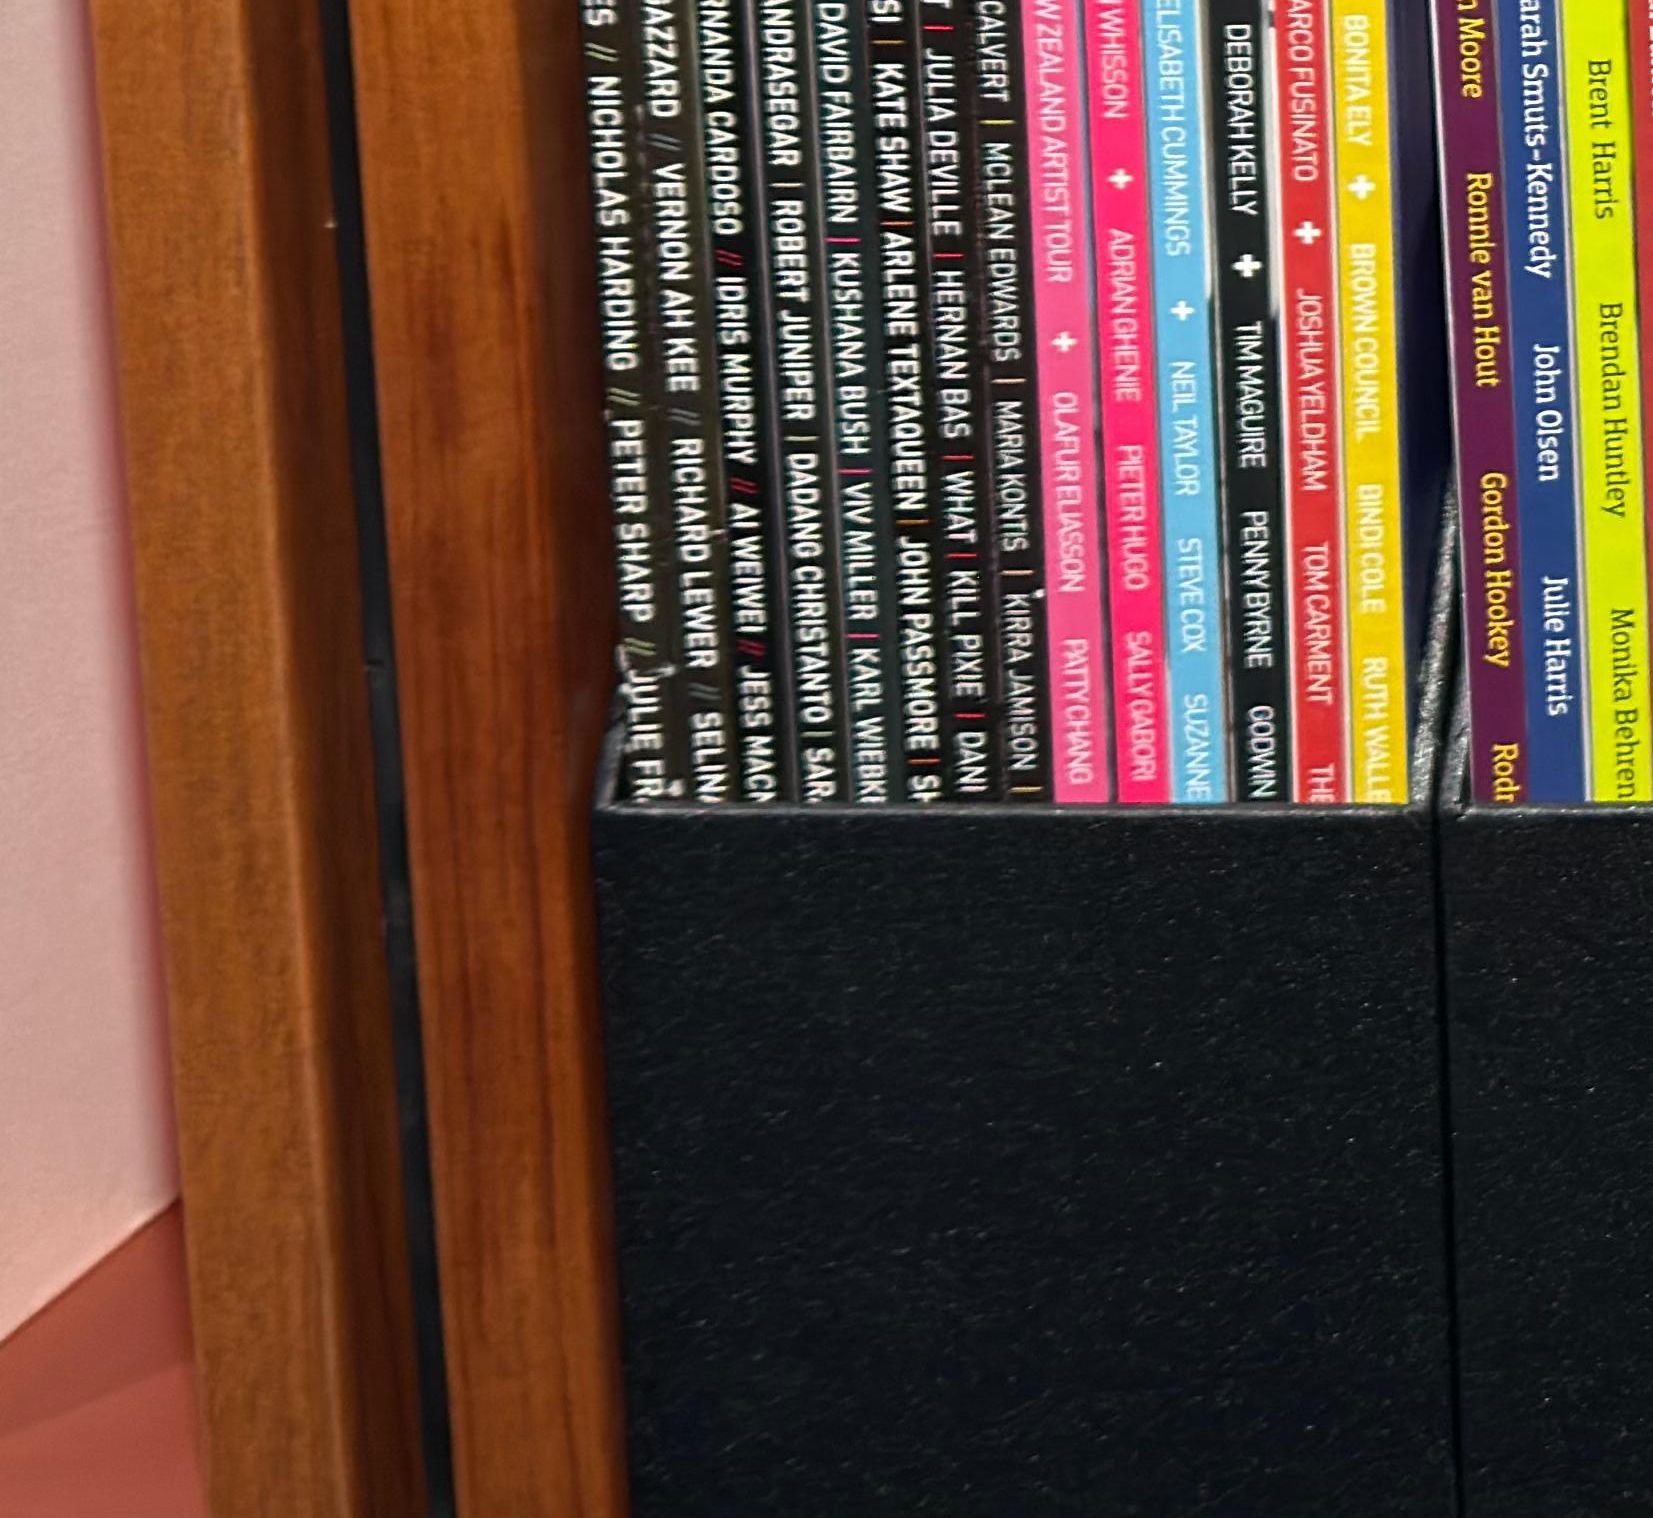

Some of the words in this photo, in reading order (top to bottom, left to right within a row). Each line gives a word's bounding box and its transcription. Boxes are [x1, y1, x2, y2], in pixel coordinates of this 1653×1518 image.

[817, 3, 850, 83] DAVID
[822, 92, 858, 222] FAIRBAIRN
[654, 163, 691, 280] VERNON
[772, 201, 809, 302] ROBERT
[662, 290, 694, 327] AH
[664, 338, 699, 391] KEE
[780, 310, 815, 419] JUNIPER
[1600, 303, 1626, 410] Brendan
[1602, 418, 1630, 517] Huntley
[1242, 511, 1270, 588] PENNY
[1358, 485, 1383, 548] BINDI
[899, 537, 930, 604] JOHN
[1360, 552, 1385, 612] COLE
[1244, 592, 1272, 667] BYRNE
[902, 614, 938, 749] PASSMORE
[1063, 639, 1089, 702] PATTY
[1065, 705, 1093, 784] CHANG
